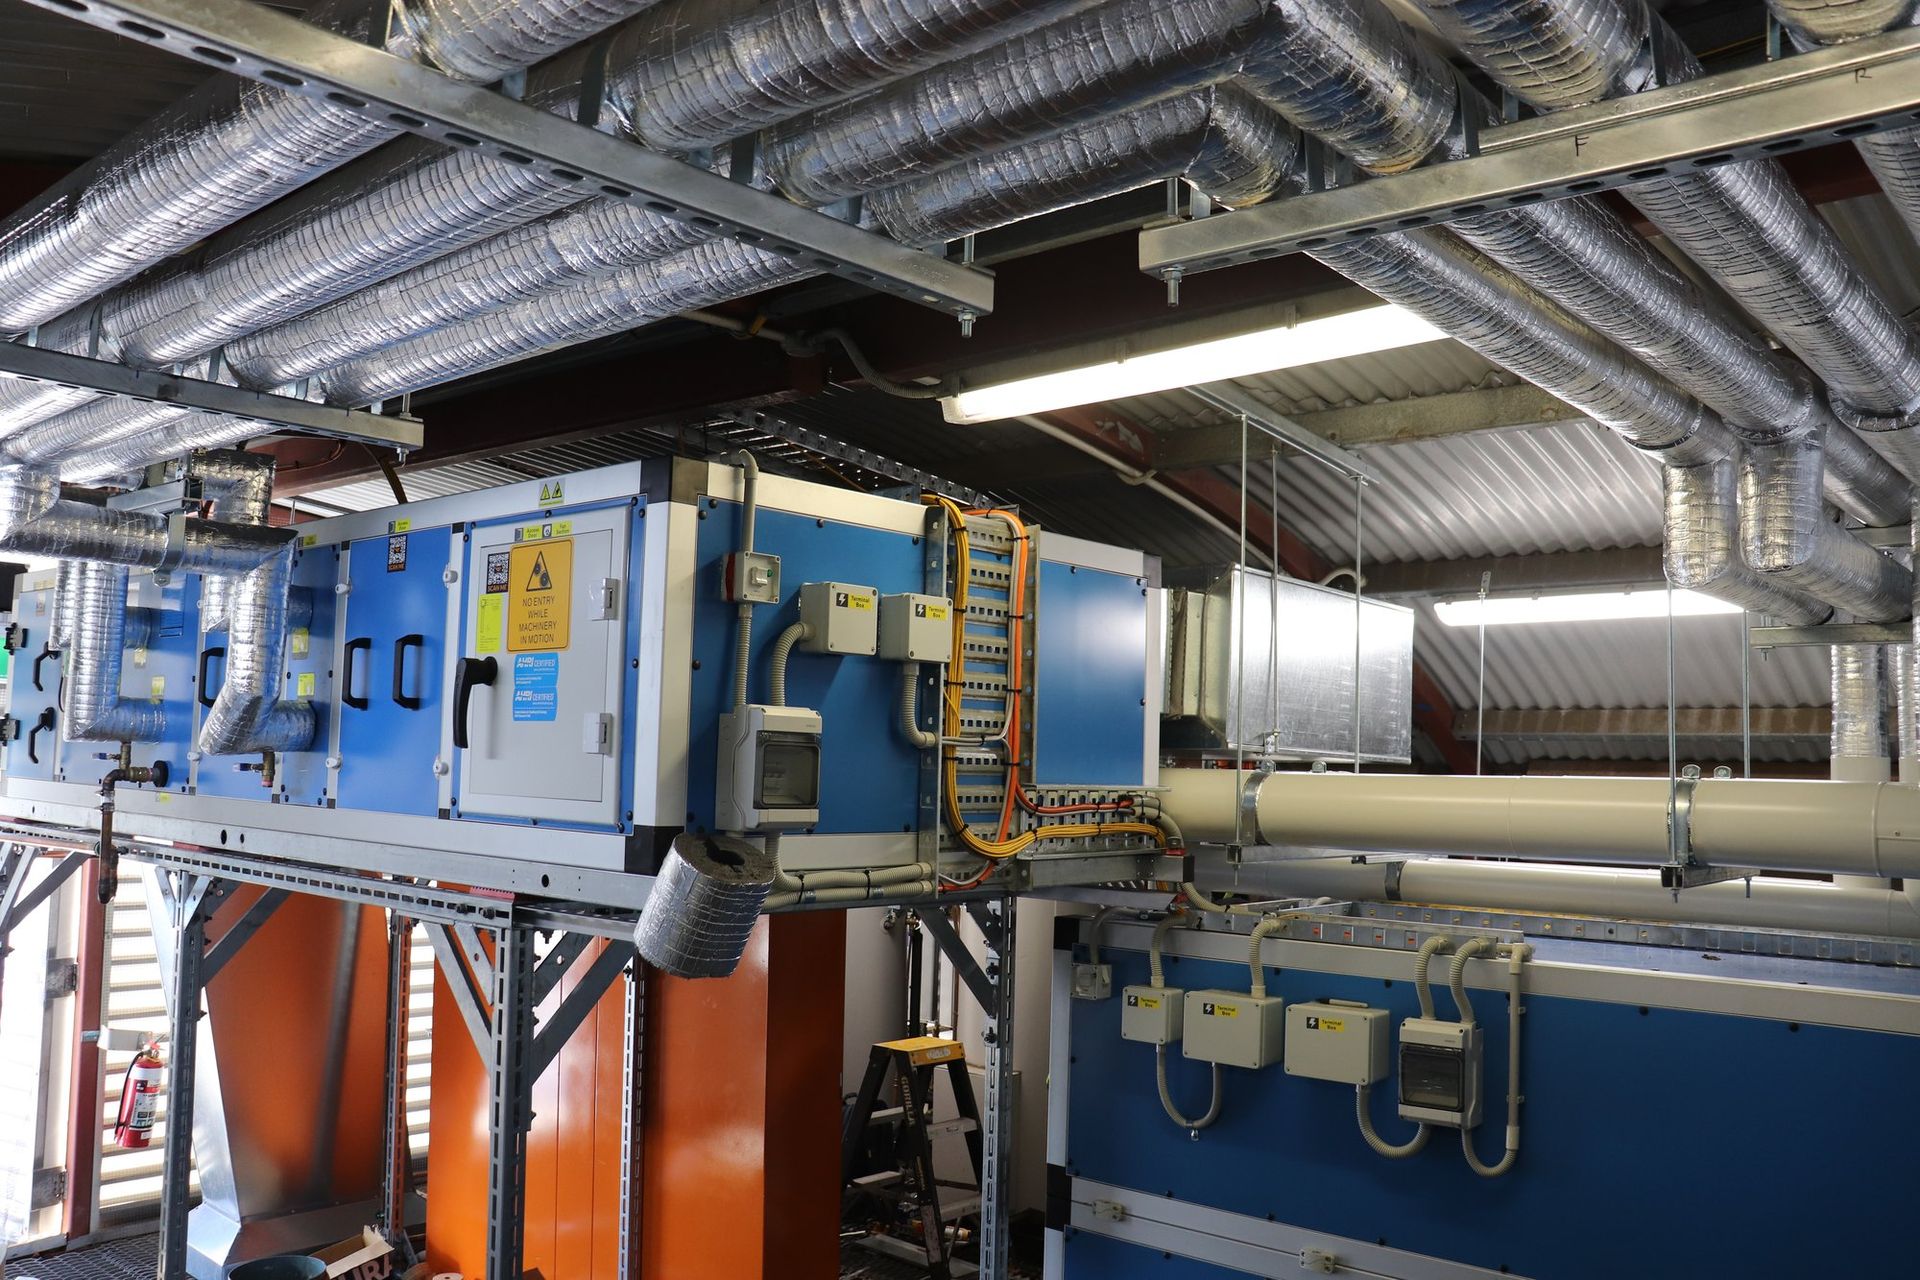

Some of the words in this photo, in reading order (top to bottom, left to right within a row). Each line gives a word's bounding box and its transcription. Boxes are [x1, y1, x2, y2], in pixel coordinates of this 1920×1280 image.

[1854, 67, 1873, 84] R
[1574, 135, 1590, 157] F
[522, 597, 533, 607] NO
[533, 595, 555, 606] ENTRY
[850, 594, 871, 603] Terminal
[527, 608, 549, 618] WHILE
[928, 605, 946, 613] Terminal
[518, 620, 557, 632] MACHINERY
[520, 635, 527, 644] IN
[527, 633, 555, 644] MOTION
[533, 659, 556, 668] CERTIFIED
[532, 693, 554, 702] CERTIFIED
[1140, 996, 1158, 1004] Terminal
[1216, 1004, 1236, 1012] Terminal
[900, 1075, 916, 1126] GORILLA
